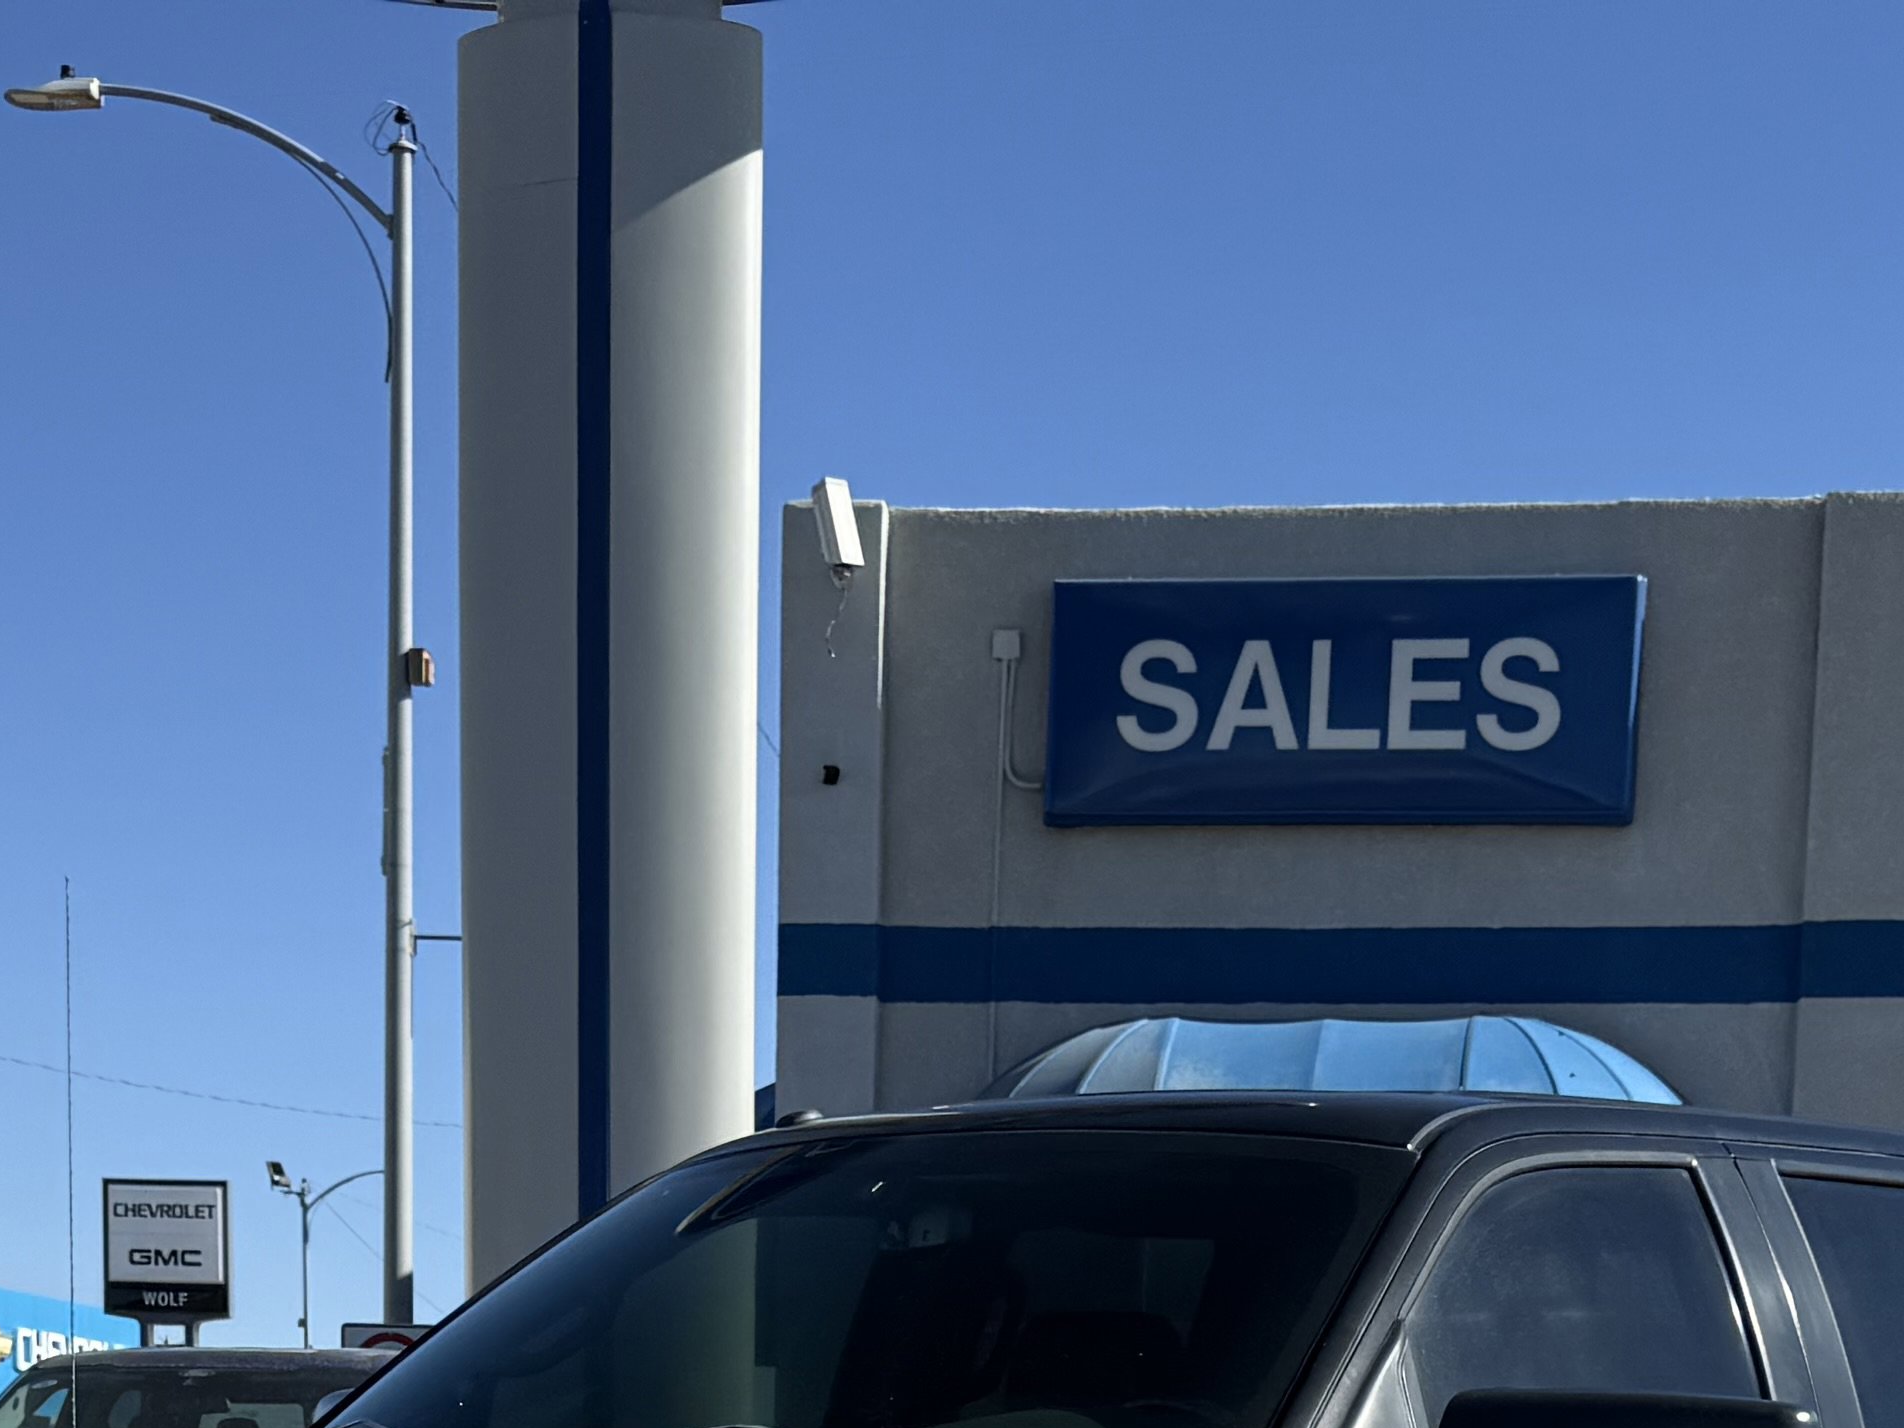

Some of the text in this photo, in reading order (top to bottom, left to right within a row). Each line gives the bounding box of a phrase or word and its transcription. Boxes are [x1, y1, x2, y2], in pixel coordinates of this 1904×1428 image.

[1116, 637, 1561, 752] SALES
[113, 1202, 216, 1219] CHEVROLET
[129, 1248, 202, 1267] GMC
[142, 1291, 188, 1306] WOLF
